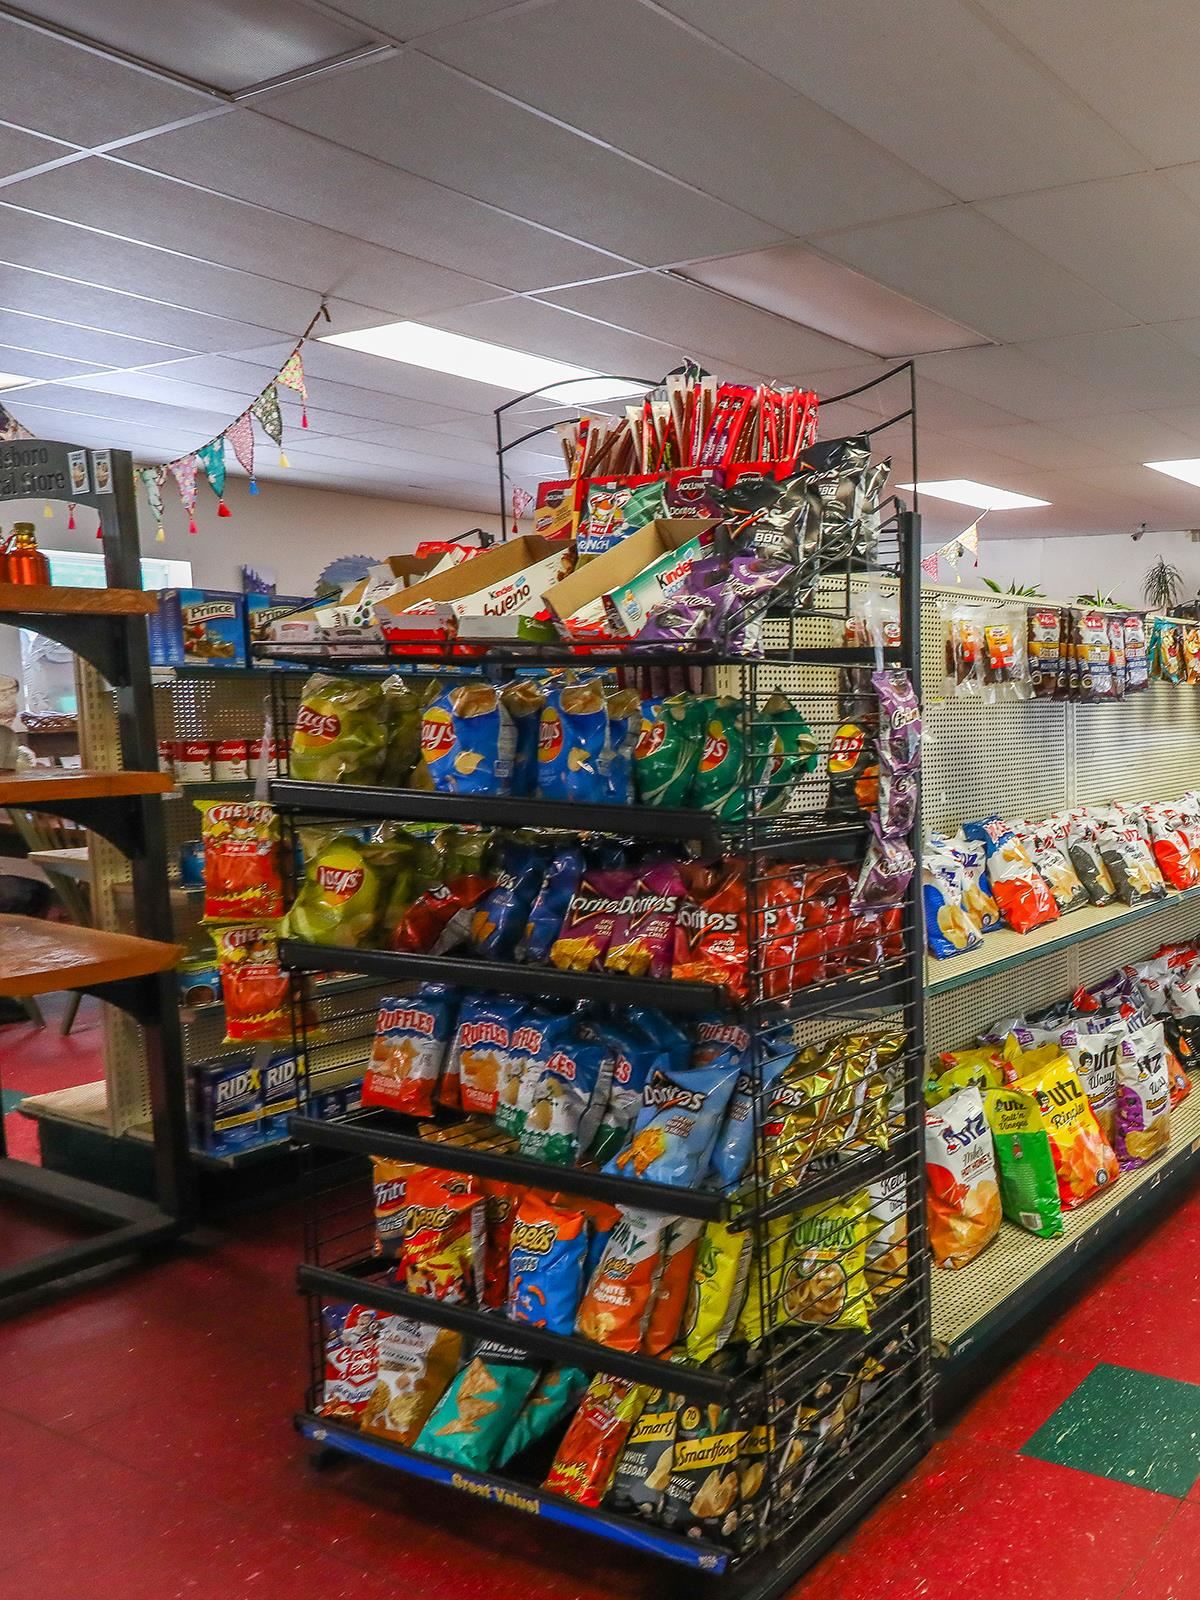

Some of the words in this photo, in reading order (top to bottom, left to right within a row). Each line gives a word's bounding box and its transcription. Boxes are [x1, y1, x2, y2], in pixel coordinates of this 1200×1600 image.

[190, 603, 233, 620] Prince
[484, 584, 531, 616] bueno
[375, 1007, 436, 1036] RUFFLES
[459, 1021, 510, 1049] RUFFLES
[644, 1083, 706, 1113] Doritos
